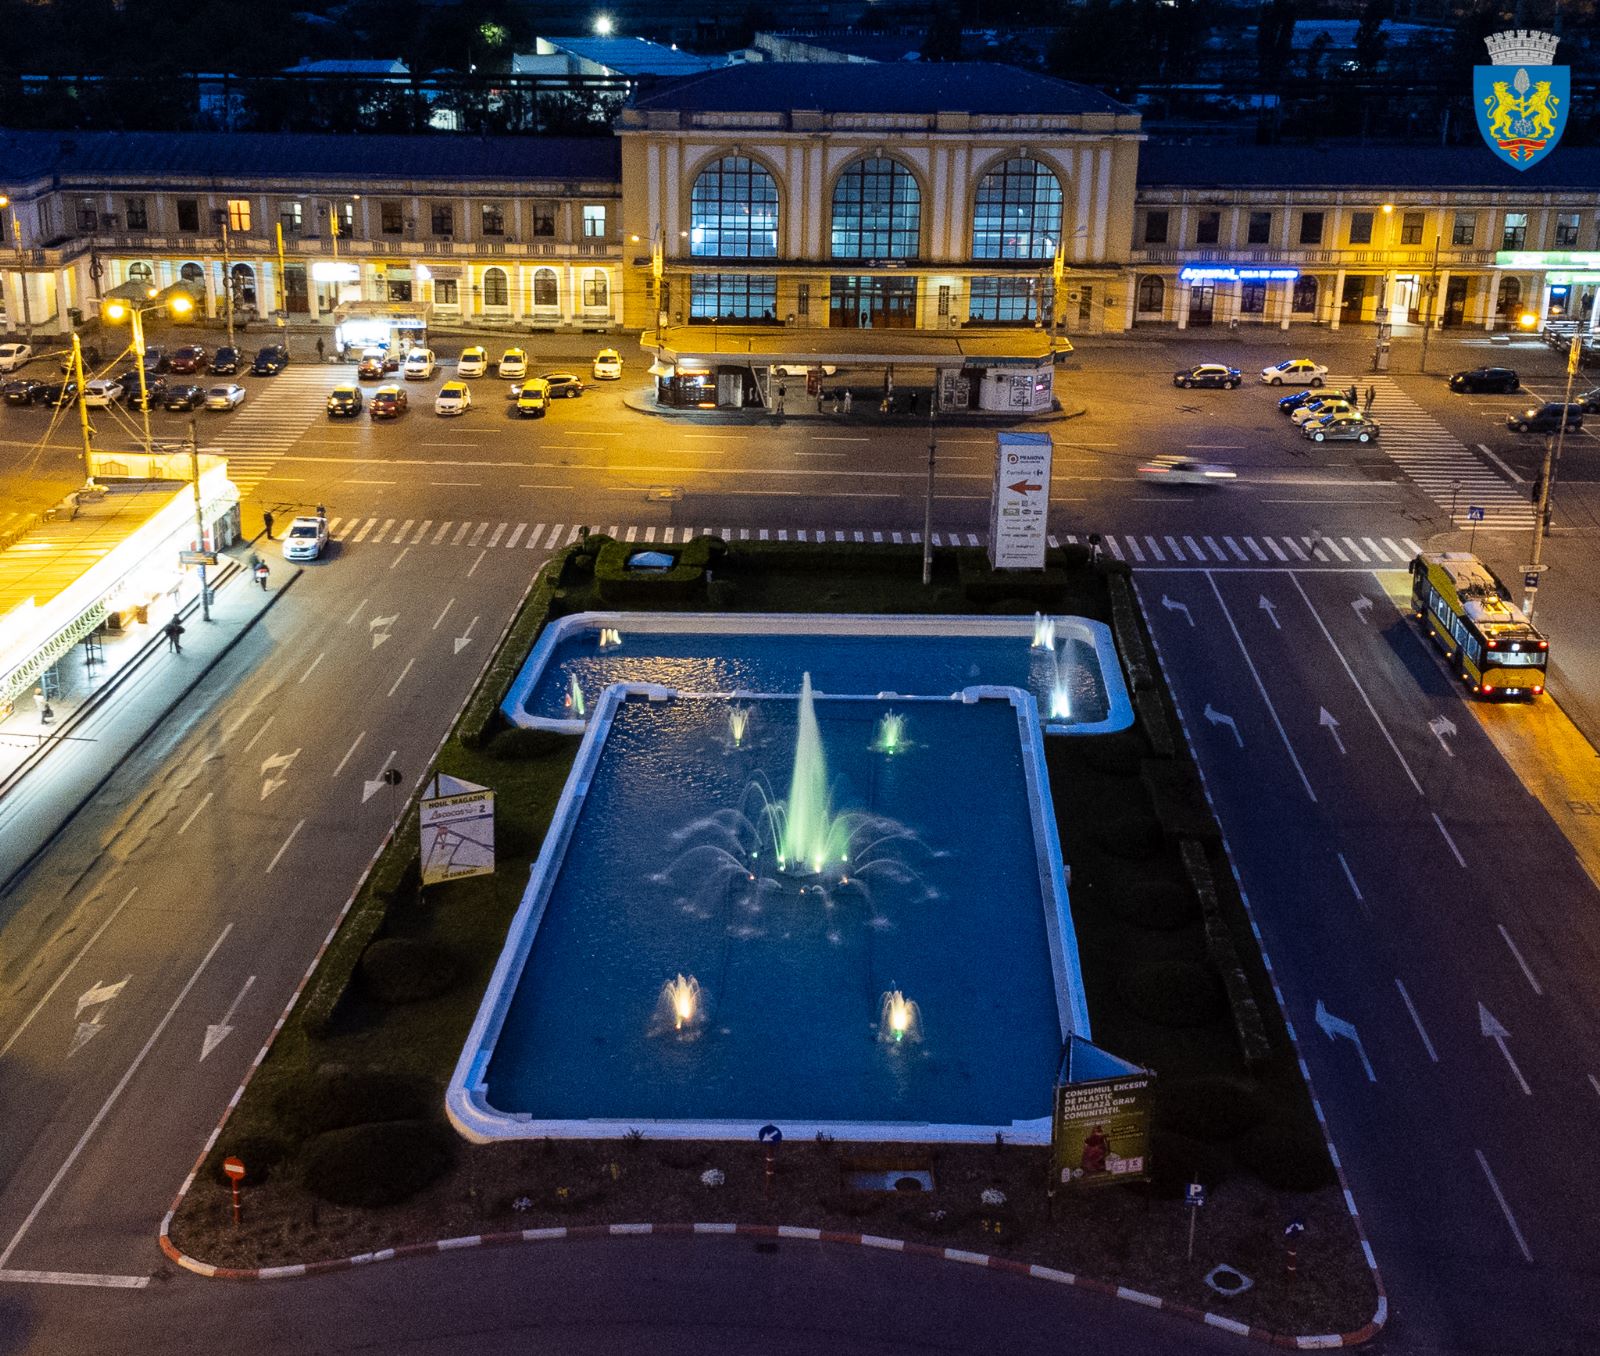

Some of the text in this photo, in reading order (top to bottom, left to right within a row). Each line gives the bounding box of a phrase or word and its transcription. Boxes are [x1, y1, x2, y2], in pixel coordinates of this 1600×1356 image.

[429, 794, 486, 809] NOUL MAGAZIN
[479, 804, 486, 813] 2
[1065, 1081, 1148, 1098] CONSUMUL EXCESIV
[1064, 1093, 1113, 1106] DE PLASTIC
[1112, 1097, 1136, 1106] GRAV
[1190, 1184, 1202, 1196] P
